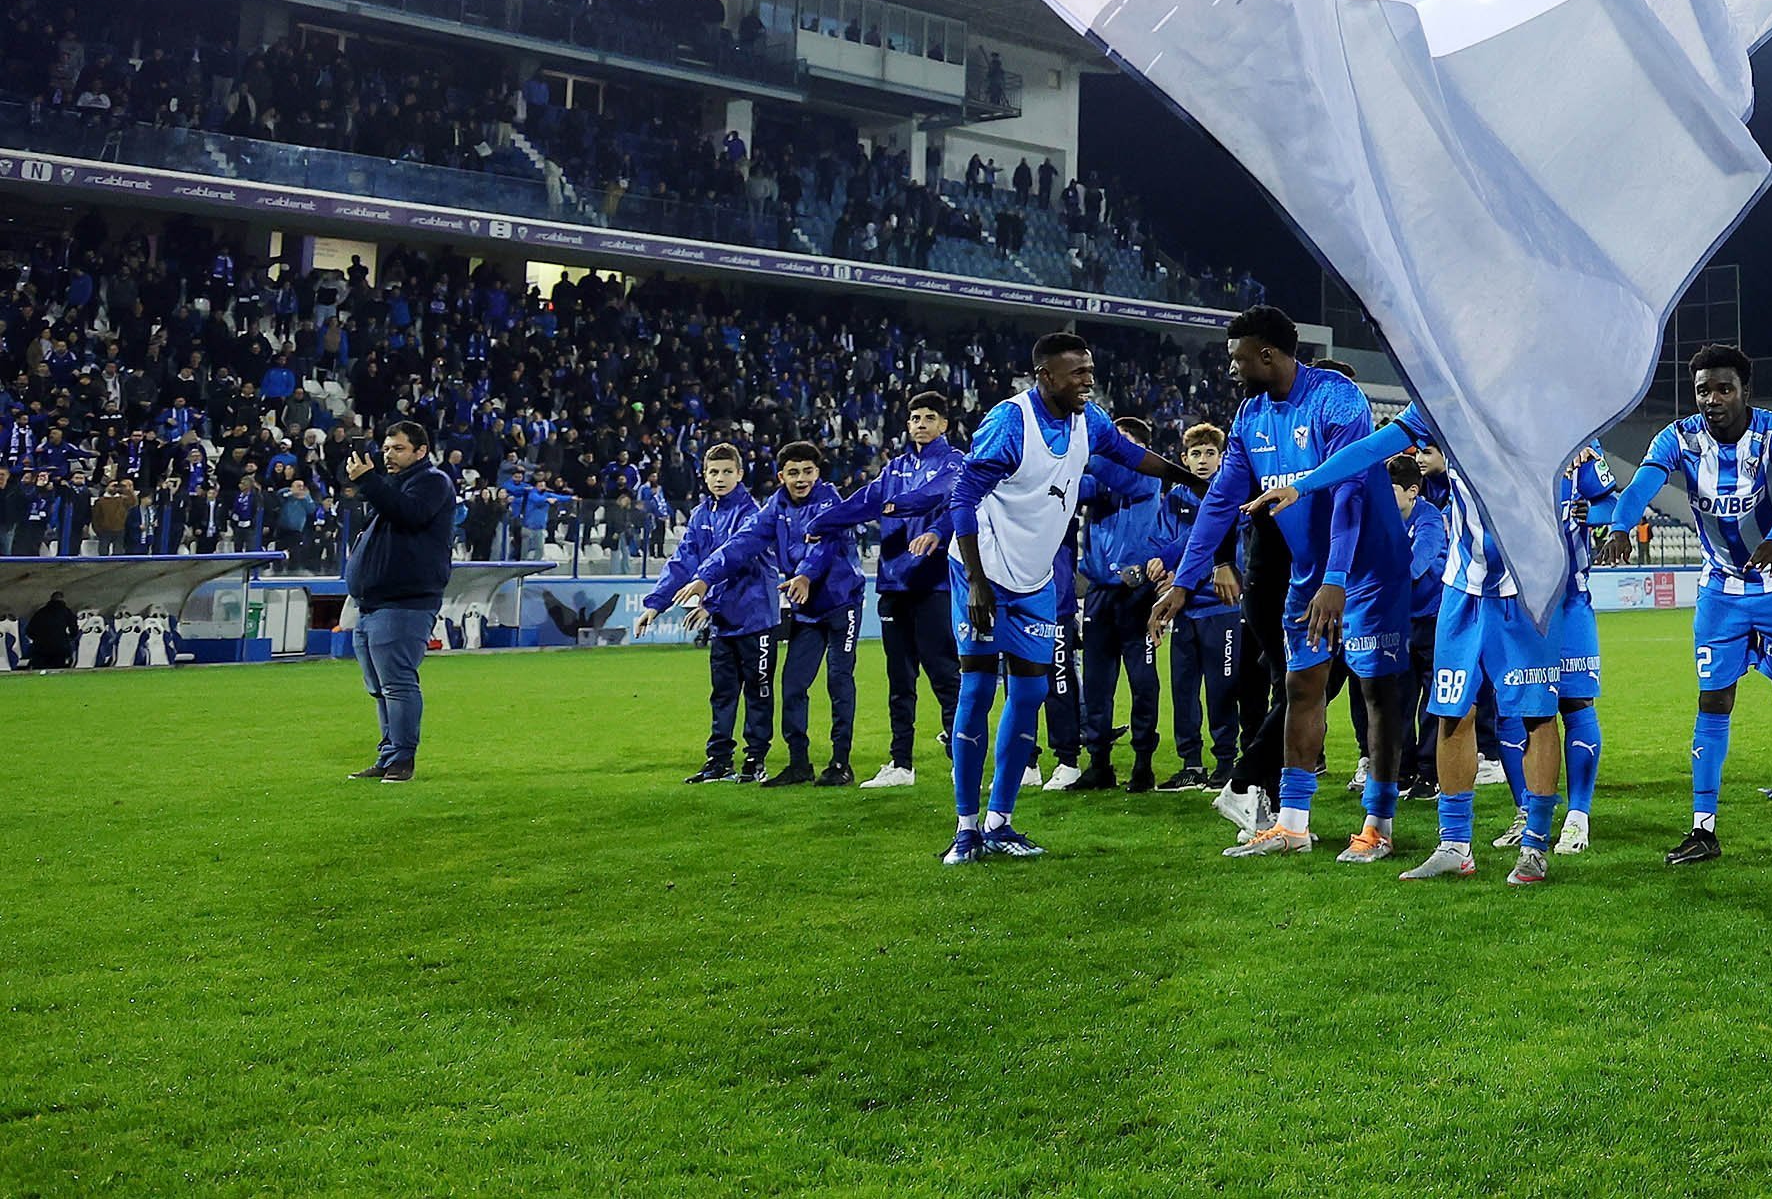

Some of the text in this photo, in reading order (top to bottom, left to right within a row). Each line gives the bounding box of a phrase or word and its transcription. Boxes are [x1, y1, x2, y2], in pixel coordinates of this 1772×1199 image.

[31, 163, 43, 179] N
[1690, 489, 1763, 515] FONBET
[1436, 668, 1467, 704] 88
